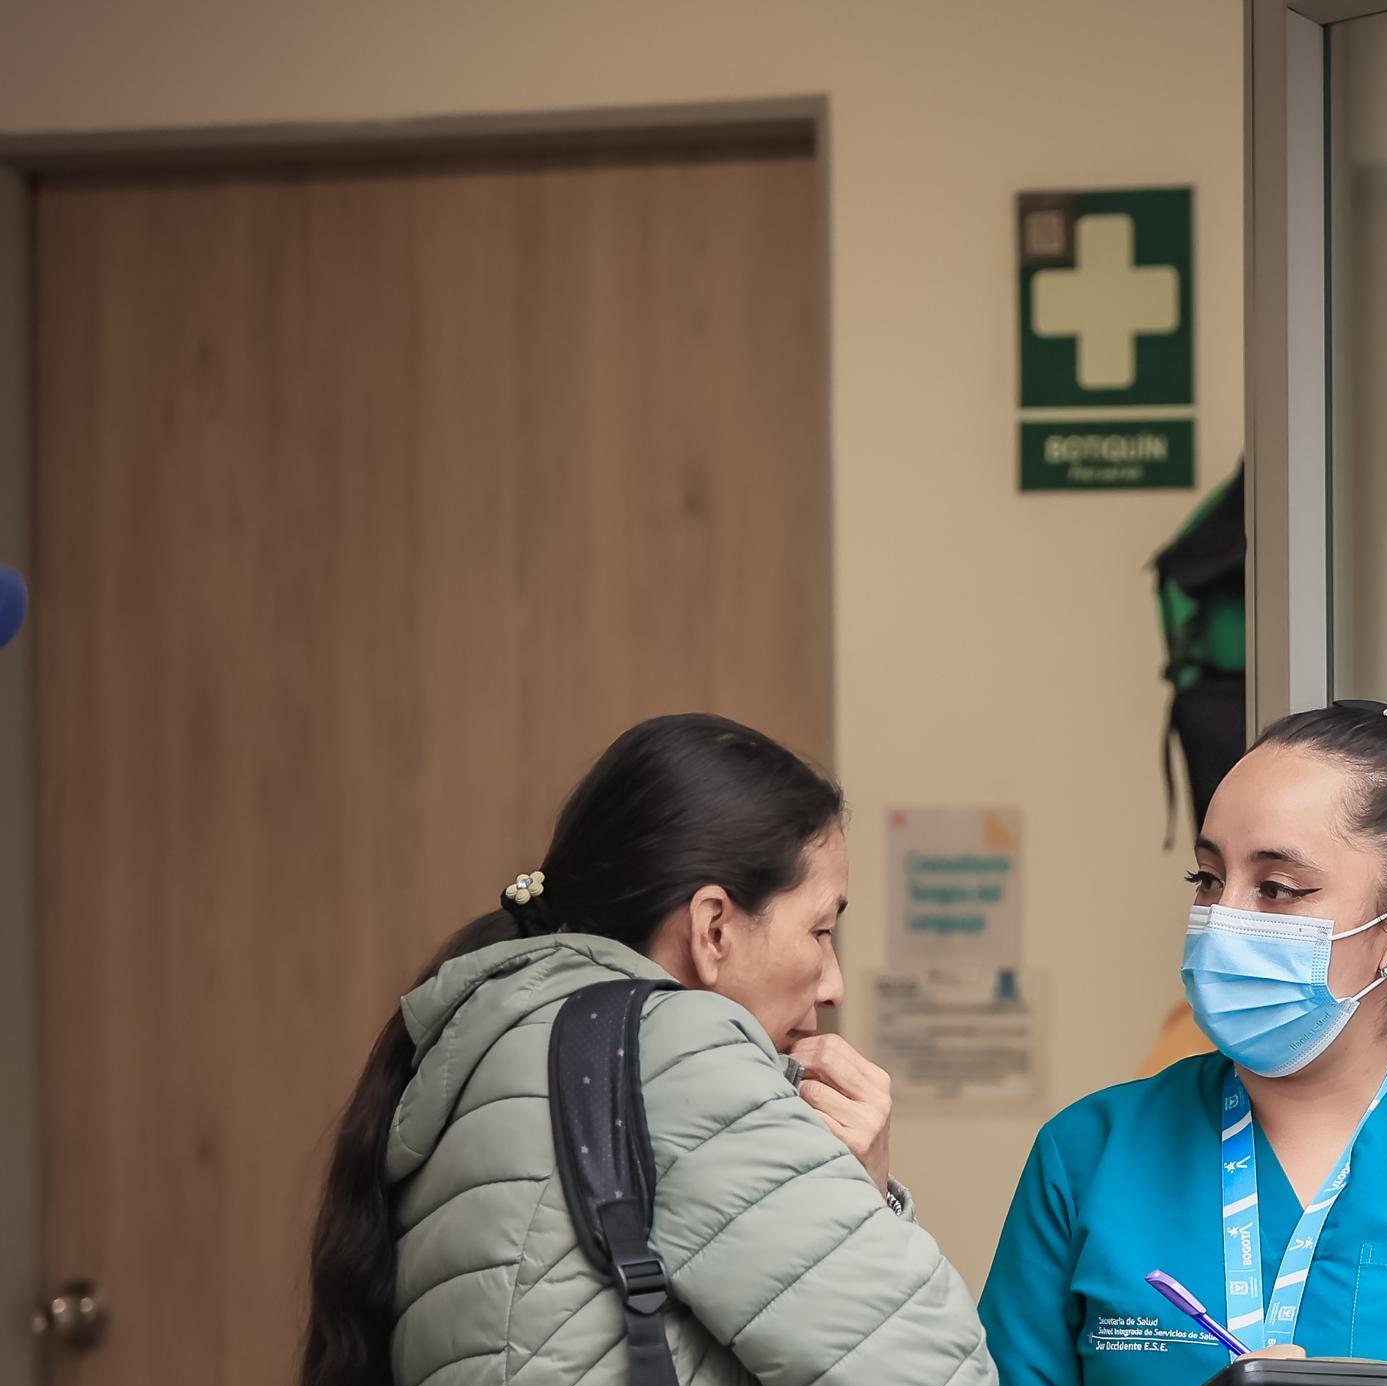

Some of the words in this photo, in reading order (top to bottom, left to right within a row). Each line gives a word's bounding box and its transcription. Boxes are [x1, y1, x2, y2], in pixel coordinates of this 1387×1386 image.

[1126, 1316, 1135, 1326] de
[1137, 1317, 1158, 1327] Salud
[1144, 1328, 1153, 1336] de
[1153, 1329, 1186, 1338] Servicios
[1188, 1331, 1198, 1339] de
[1199, 1332, 1219, 1341] Salu
[1106, 1341, 1142, 1351] Occidente
[1144, 1342, 1168, 1352] E.S.E.
